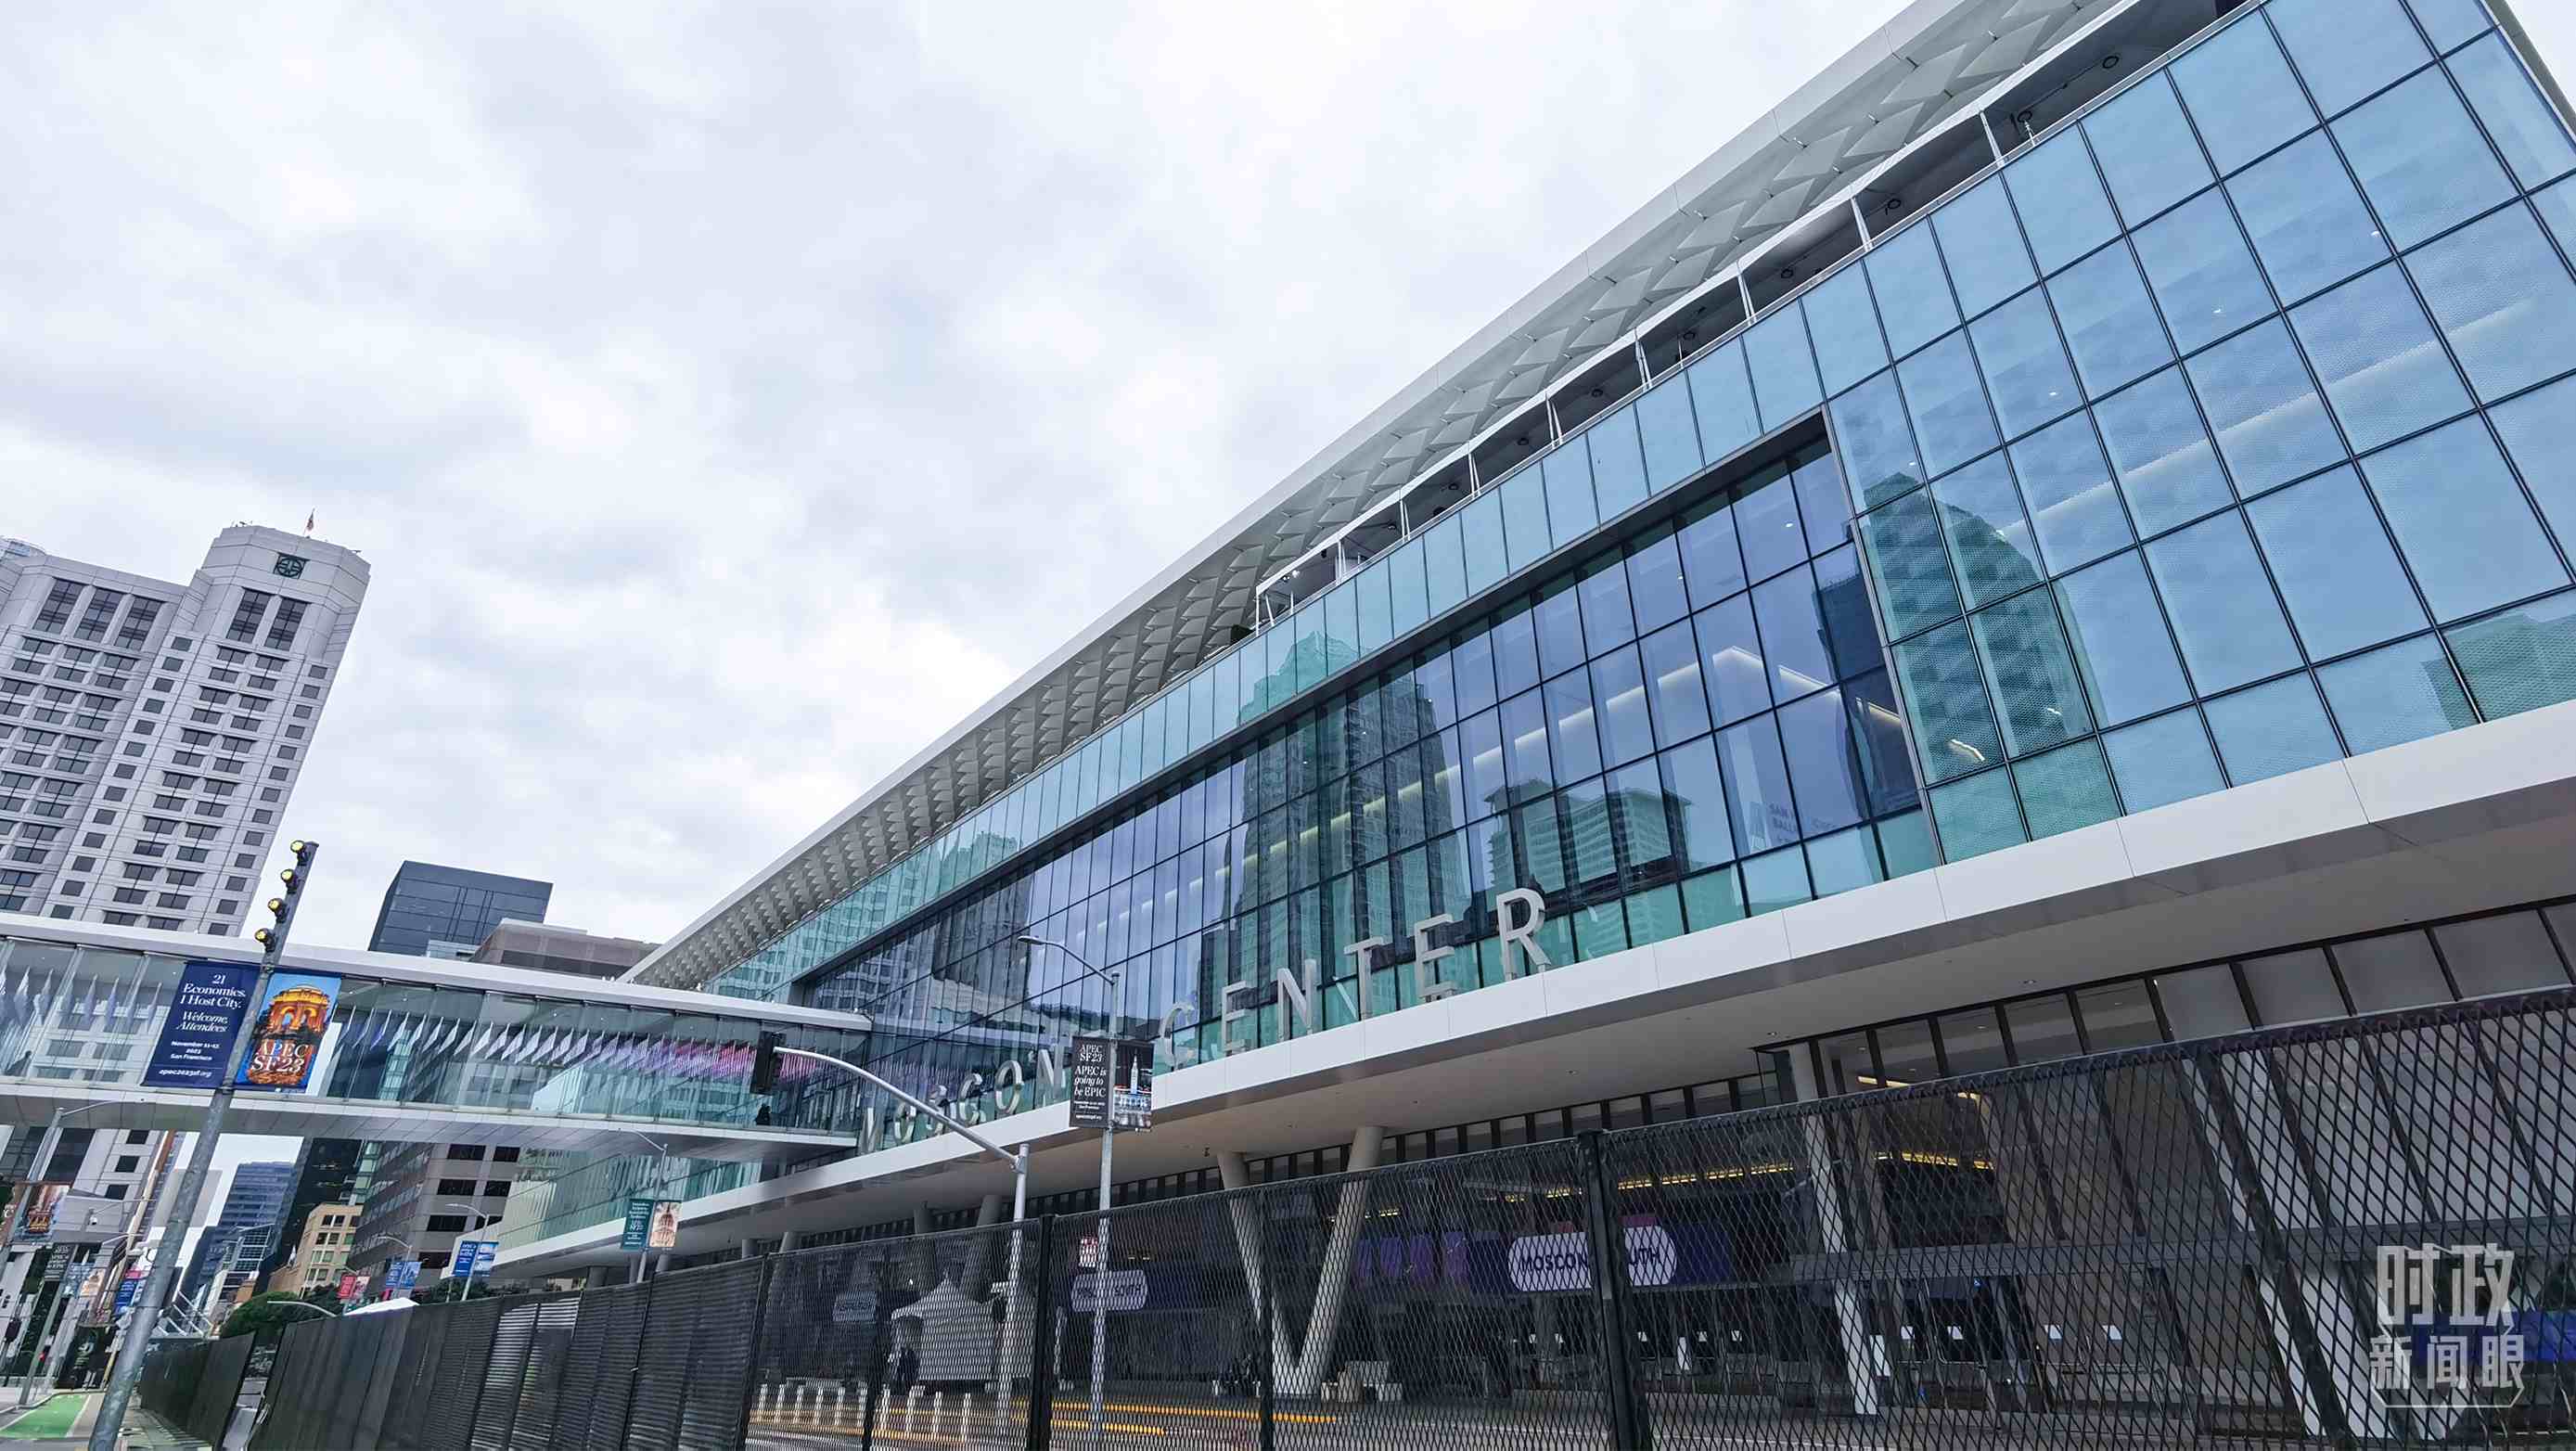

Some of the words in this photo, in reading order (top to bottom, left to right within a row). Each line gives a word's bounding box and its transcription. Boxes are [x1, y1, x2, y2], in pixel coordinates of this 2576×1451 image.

[211, 974, 226, 984] 21
[1158, 887, 1552, 1069] CENTER
[188, 995, 216, 1006] Host
[216, 997, 242, 1009] City.
[176, 1021, 227, 1033] Attendees
[255, 1038, 309, 1057] APEC
[1079, 1044, 1103, 1053] APEC
[1080, 1053, 1103, 1062] SF23
[251, 1056, 305, 1072] SF23
[1074, 1065, 1098, 1076] APEC
[1099, 1067, 1107, 1076] is
[1074, 1075, 1096, 1086] going
[1074, 1086, 1083, 1096] be
[1083, 1088, 1107, 1098] EPIC
[1521, 1253, 1589, 1271] MOSCON
